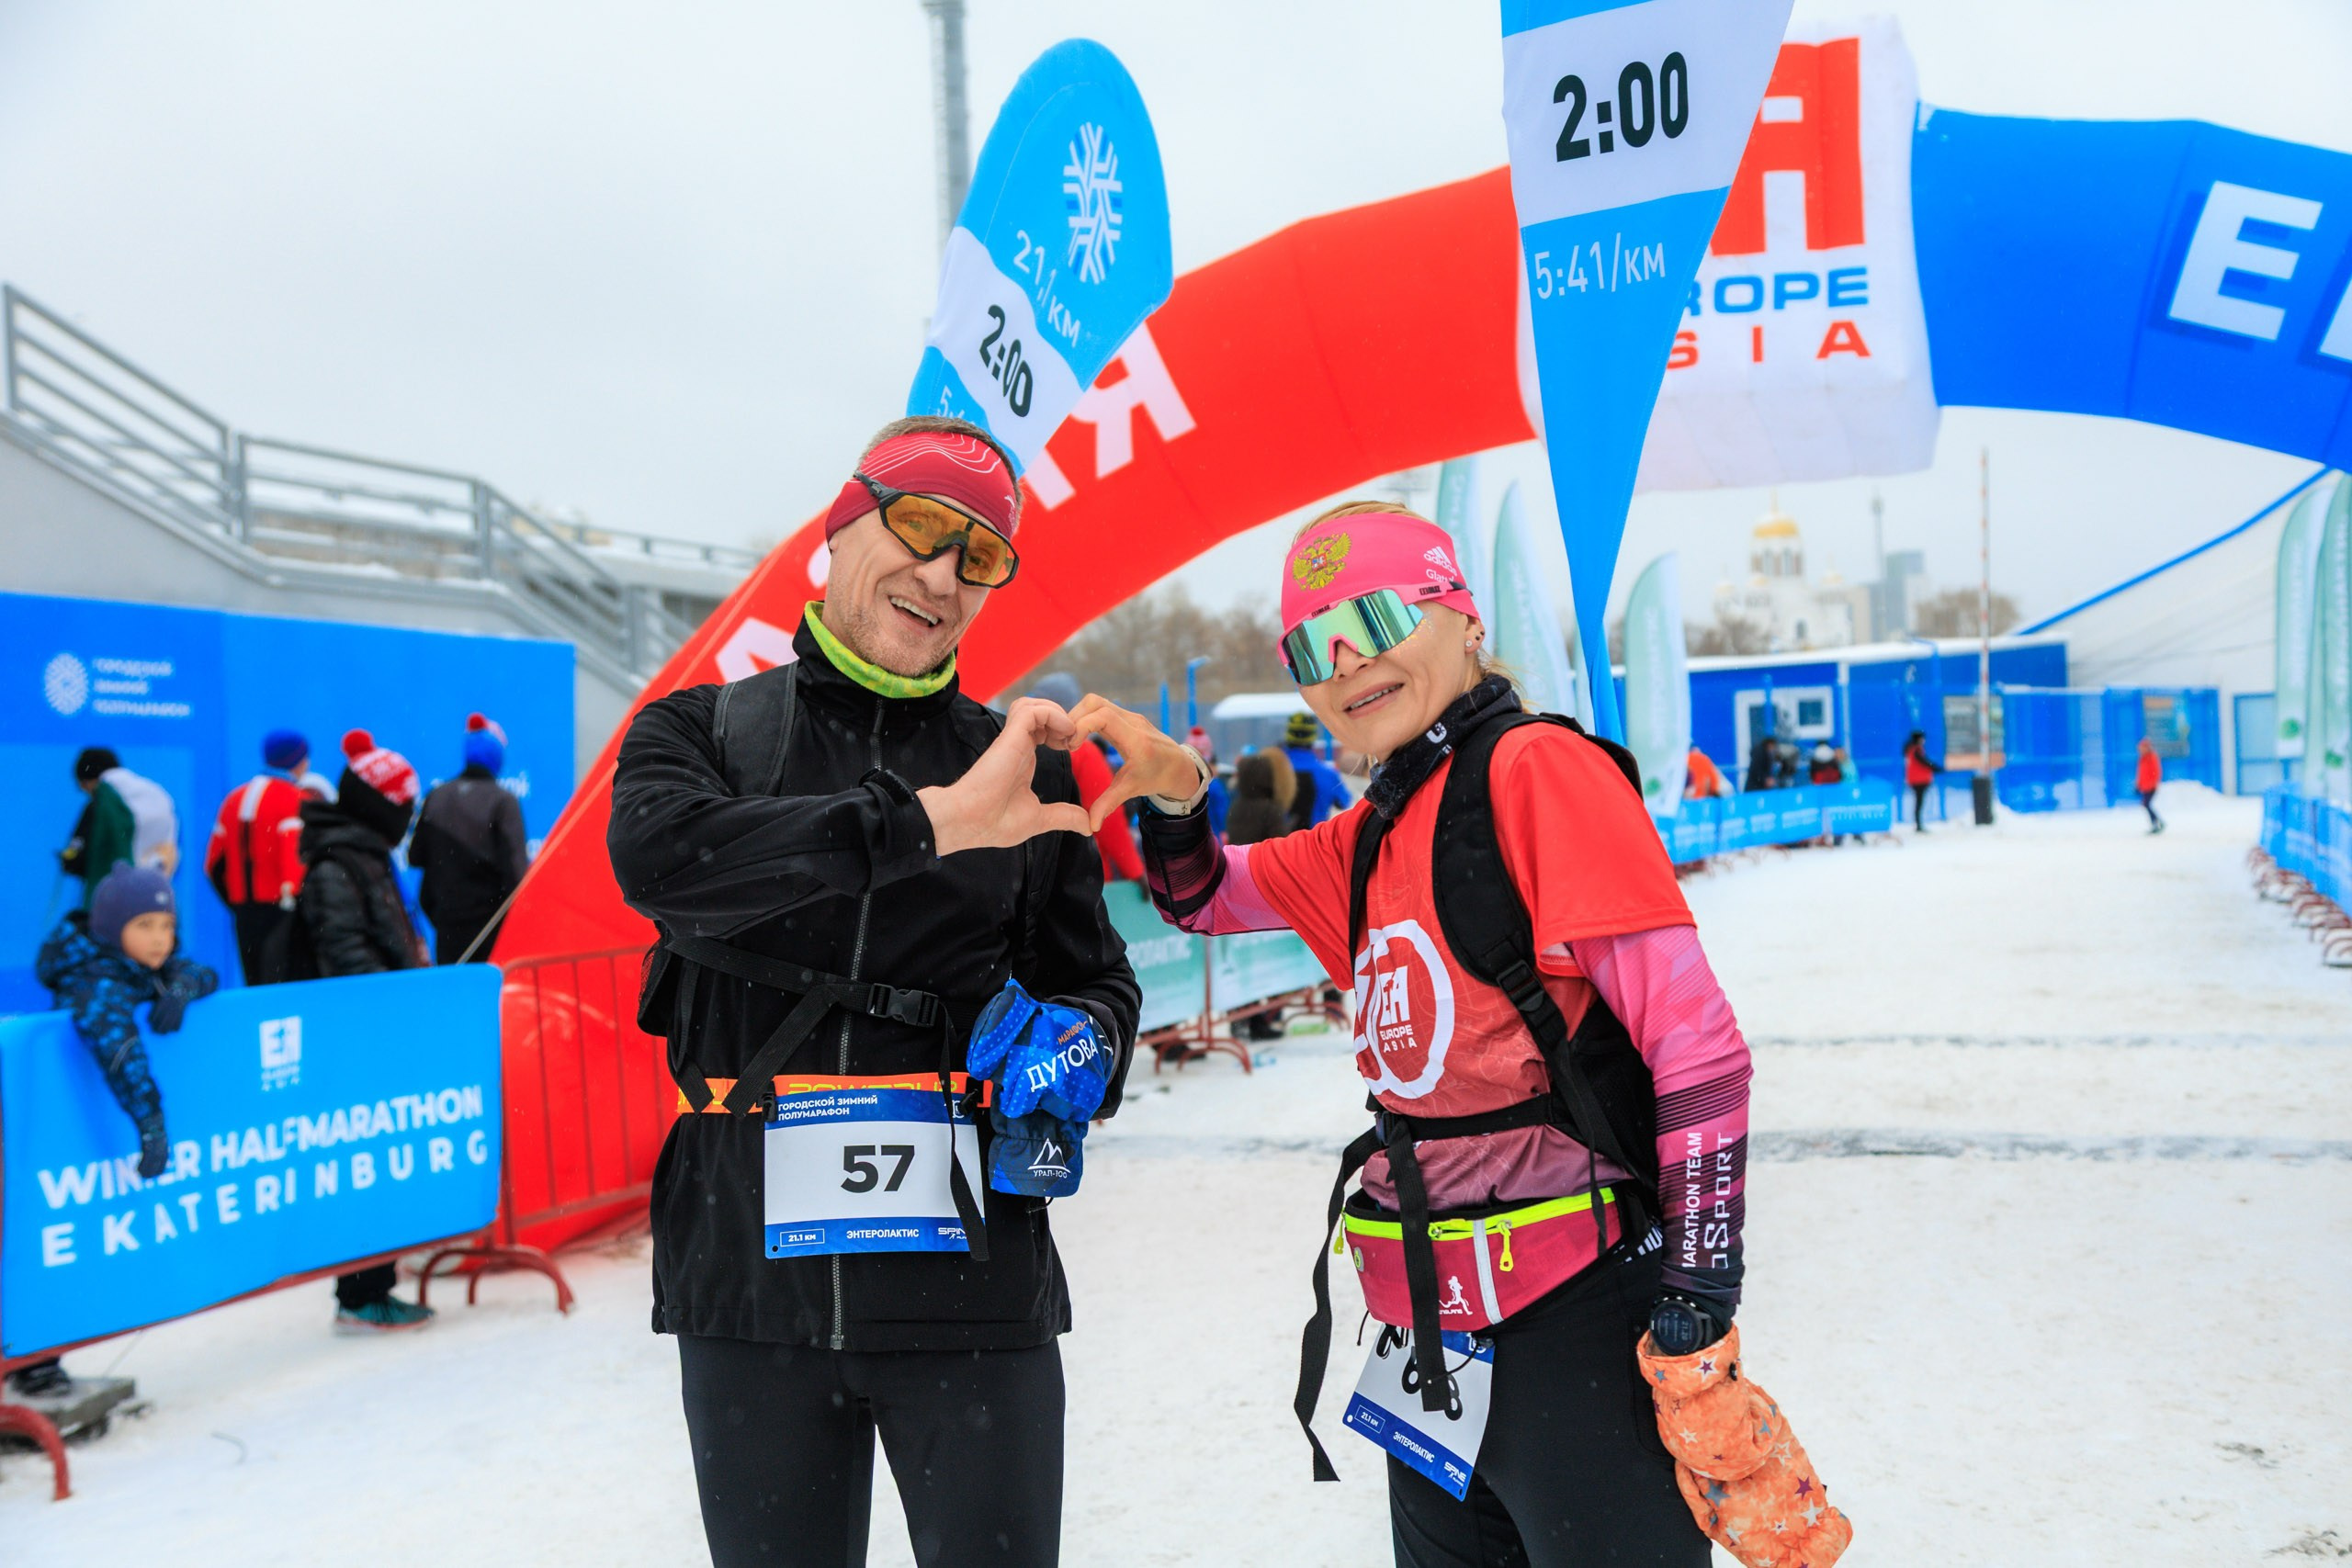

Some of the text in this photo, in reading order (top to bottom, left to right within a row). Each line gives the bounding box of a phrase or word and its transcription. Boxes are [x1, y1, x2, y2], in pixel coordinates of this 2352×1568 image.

[1553, 51, 1689, 163] 2:00
[978, 304, 1034, 418] 2:00
[1379, 1024, 1414, 1041] EUROPE
[1383, 1037, 1418, 1054] ASIA
[1026, 1033, 1099, 1093] ДУТОВА
[778, 1095, 877, 1111] ГОРОДСКОЙ ЗИМНИЙ
[778, 1108, 850, 1121] ПОЛУМАРАФОН
[210, 1084, 484, 1173] HALFMARATHON
[841, 1144, 915, 1194] 57
[1686, 1132, 1702, 1179] TEAM
[41, 1130, 489, 1268] EKATERINBURG
[788, 1233, 804, 1242] 21.1
[846, 1228, 919, 1239] ЭНТЕРОЛАКТИС
[1393, 1431, 1435, 1463] ЭНТЕРОЛАКТИС
